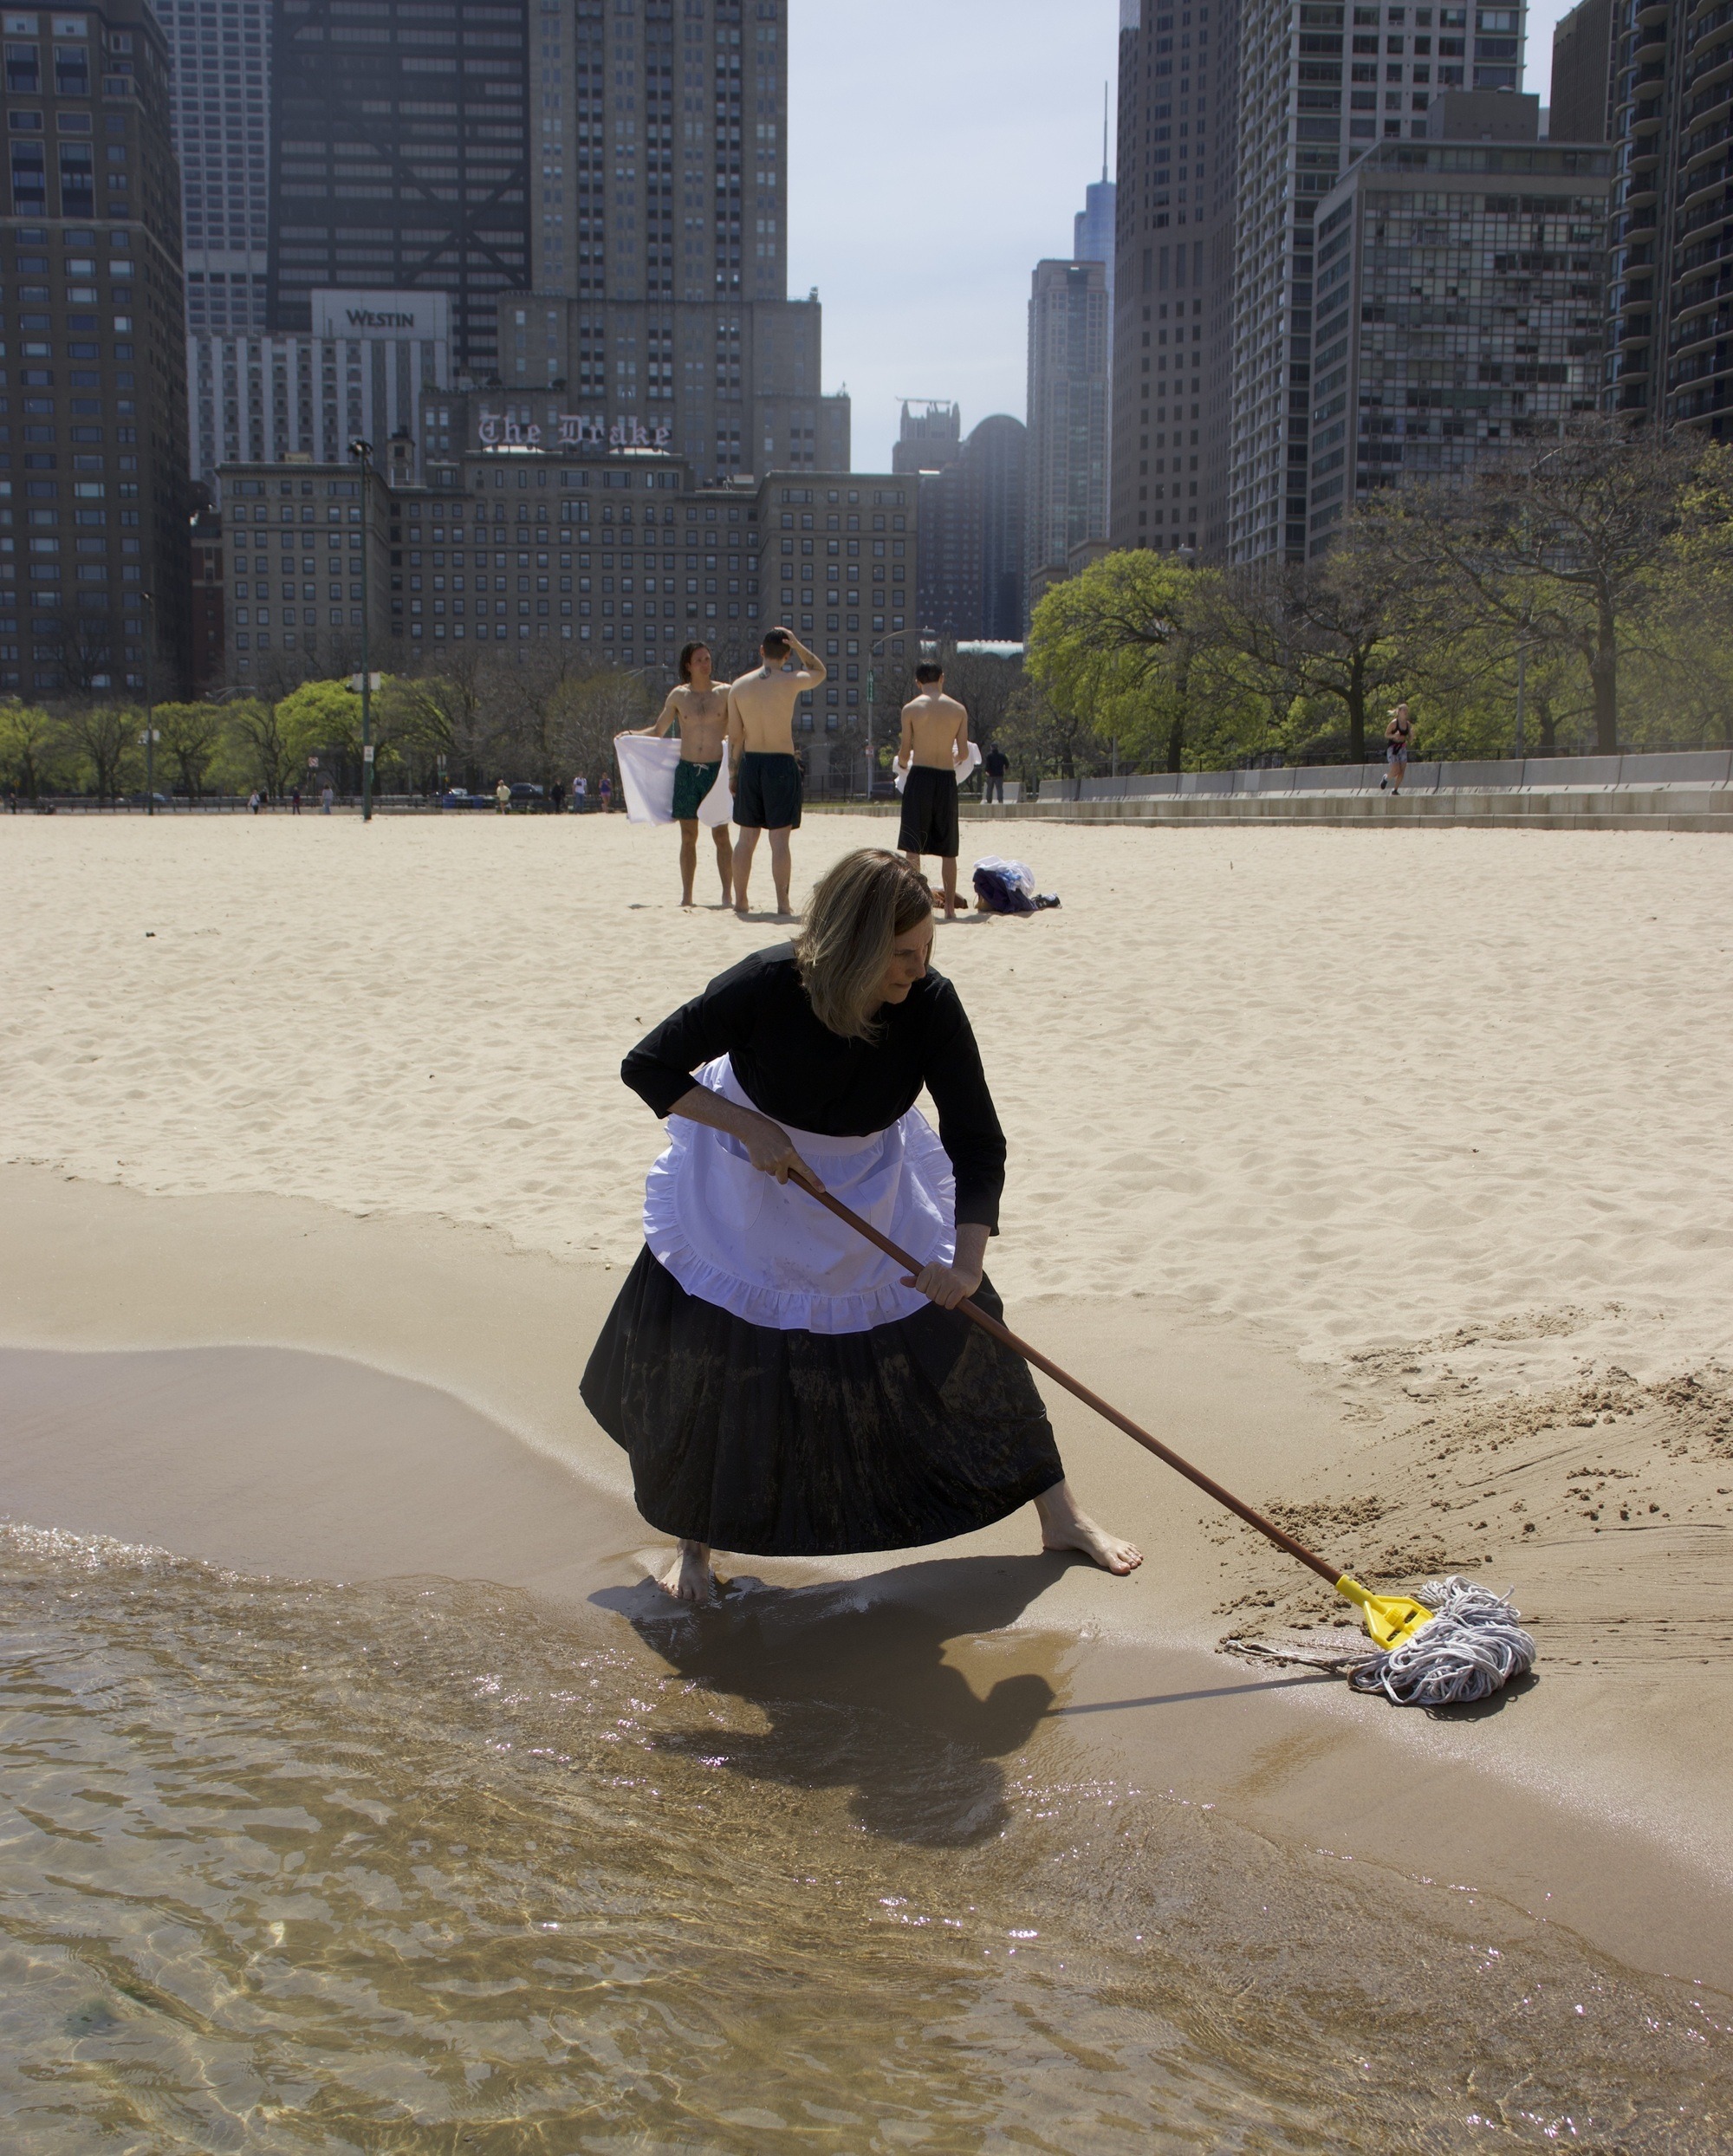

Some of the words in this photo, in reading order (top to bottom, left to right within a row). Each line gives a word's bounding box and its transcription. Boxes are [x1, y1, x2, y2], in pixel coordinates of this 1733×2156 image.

[346, 308, 414, 328] WESTIN
[478, 413, 542, 444] The
[558, 414, 671, 445] Drake
